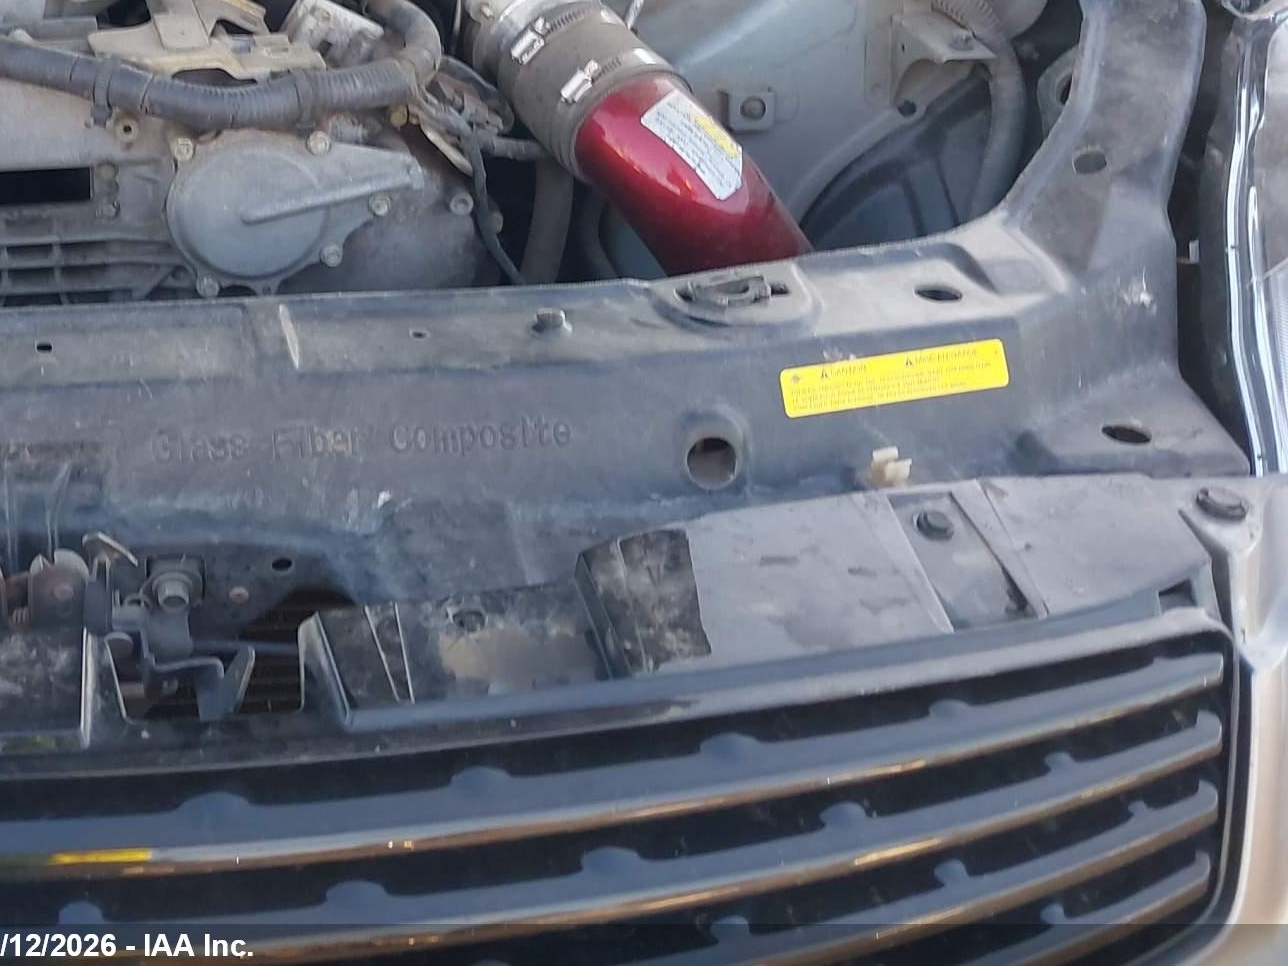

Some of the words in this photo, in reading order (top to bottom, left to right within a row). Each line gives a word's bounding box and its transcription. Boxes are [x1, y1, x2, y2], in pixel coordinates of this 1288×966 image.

[150, 428, 249, 462] Glass
[271, 422, 358, 461] Fiber
[389, 416, 573, 458] Composite
